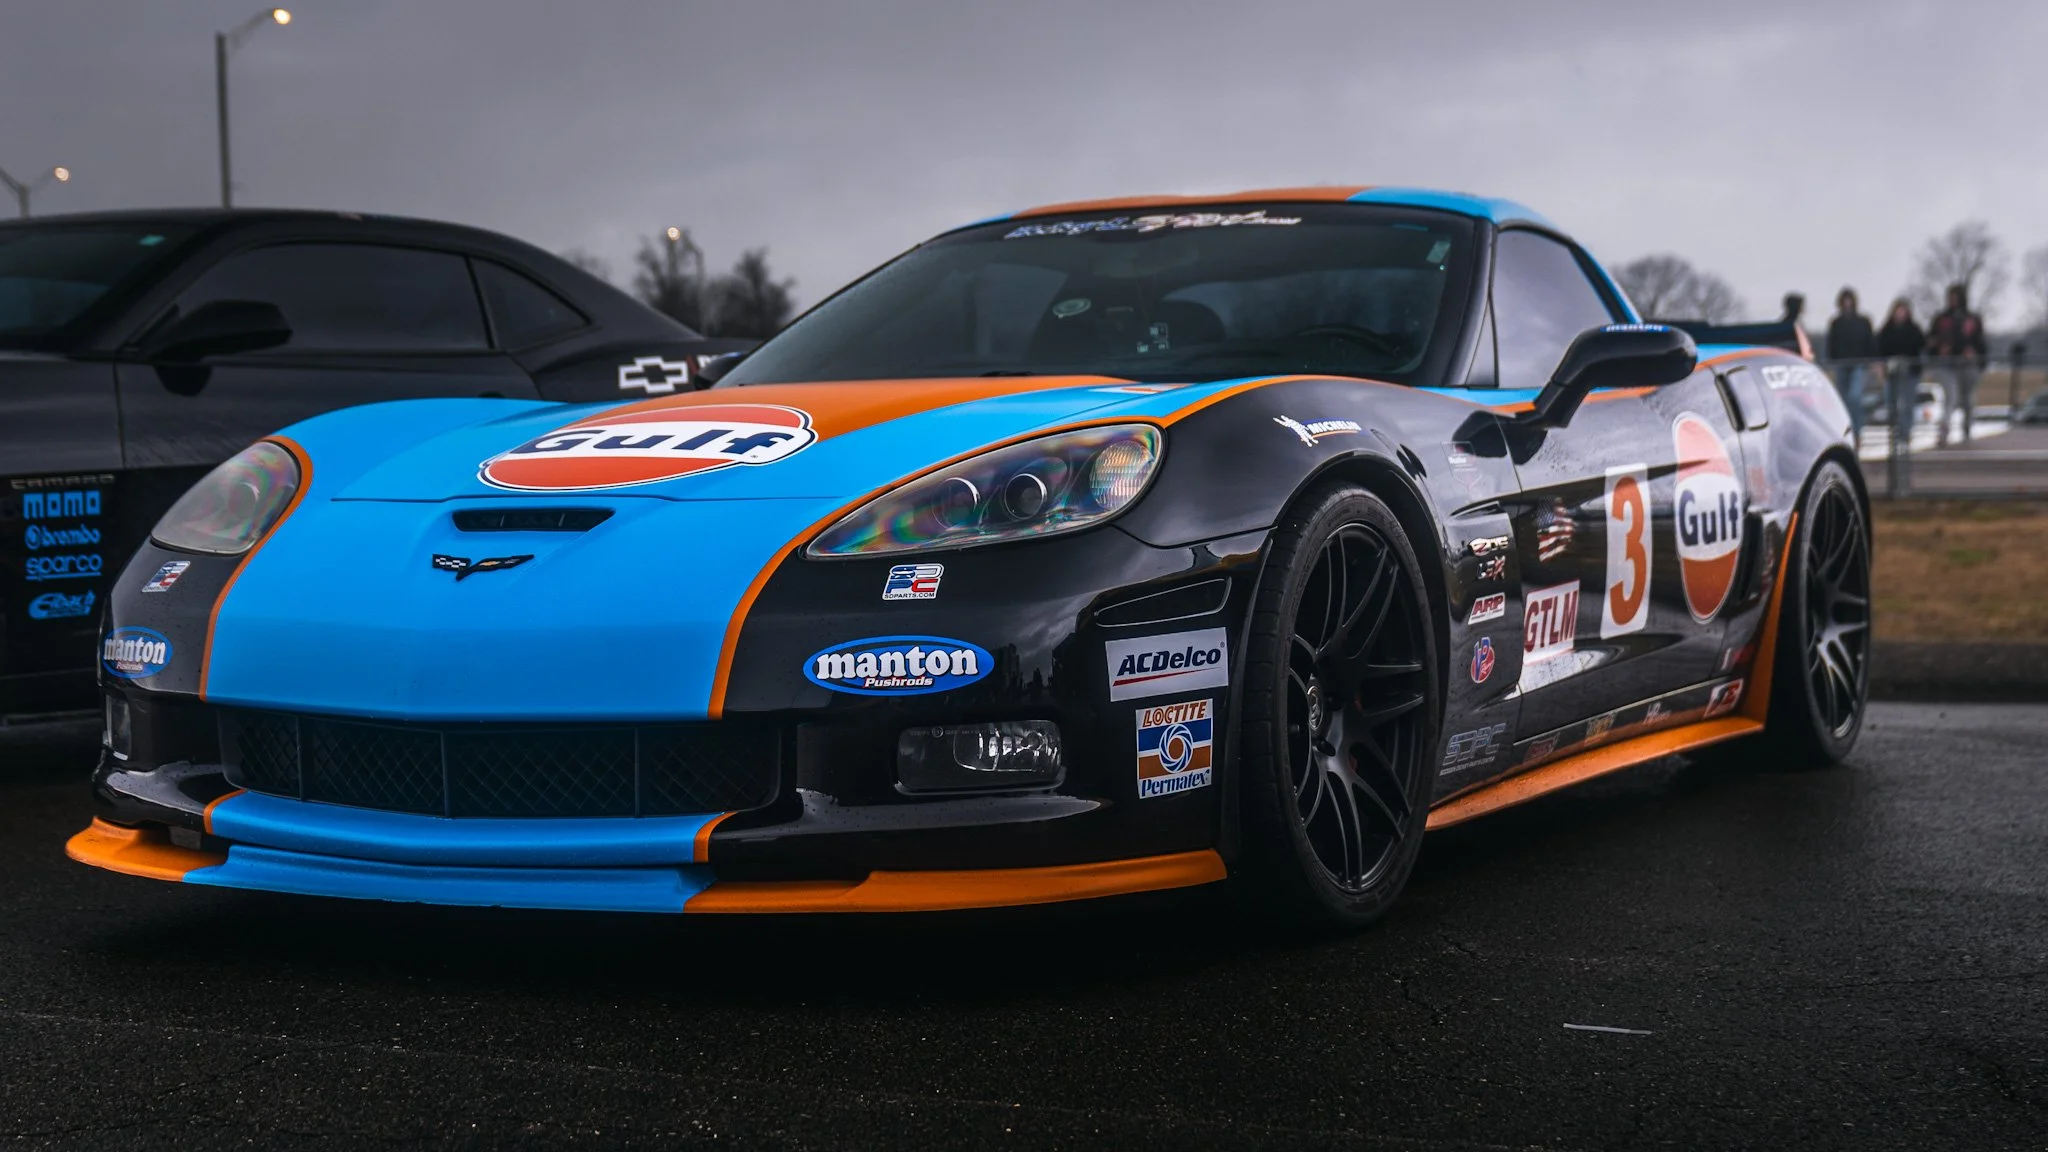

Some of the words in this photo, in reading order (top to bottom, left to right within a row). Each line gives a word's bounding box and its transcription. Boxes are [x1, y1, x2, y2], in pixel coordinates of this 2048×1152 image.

[1306, 420, 1362, 434] MICHELIN
[508, 428, 796, 456] Gulf
[1679, 489, 1738, 547] Gulf
[41, 524, 101, 547] brembo
[1609, 475, 1648, 626] 3
[26, 554, 103, 581] sparco
[1471, 594, 1504, 616] ARP
[1523, 590, 1579, 653] GTLM
[103, 636, 166, 665] manton
[816, 646, 979, 680] manton
[1117, 646, 1221, 677] ACDelco
[864, 676, 933, 688] Pushrods
[1142, 700, 1208, 728] LOCTITE
[1141, 768, 1210, 798] Permatex
